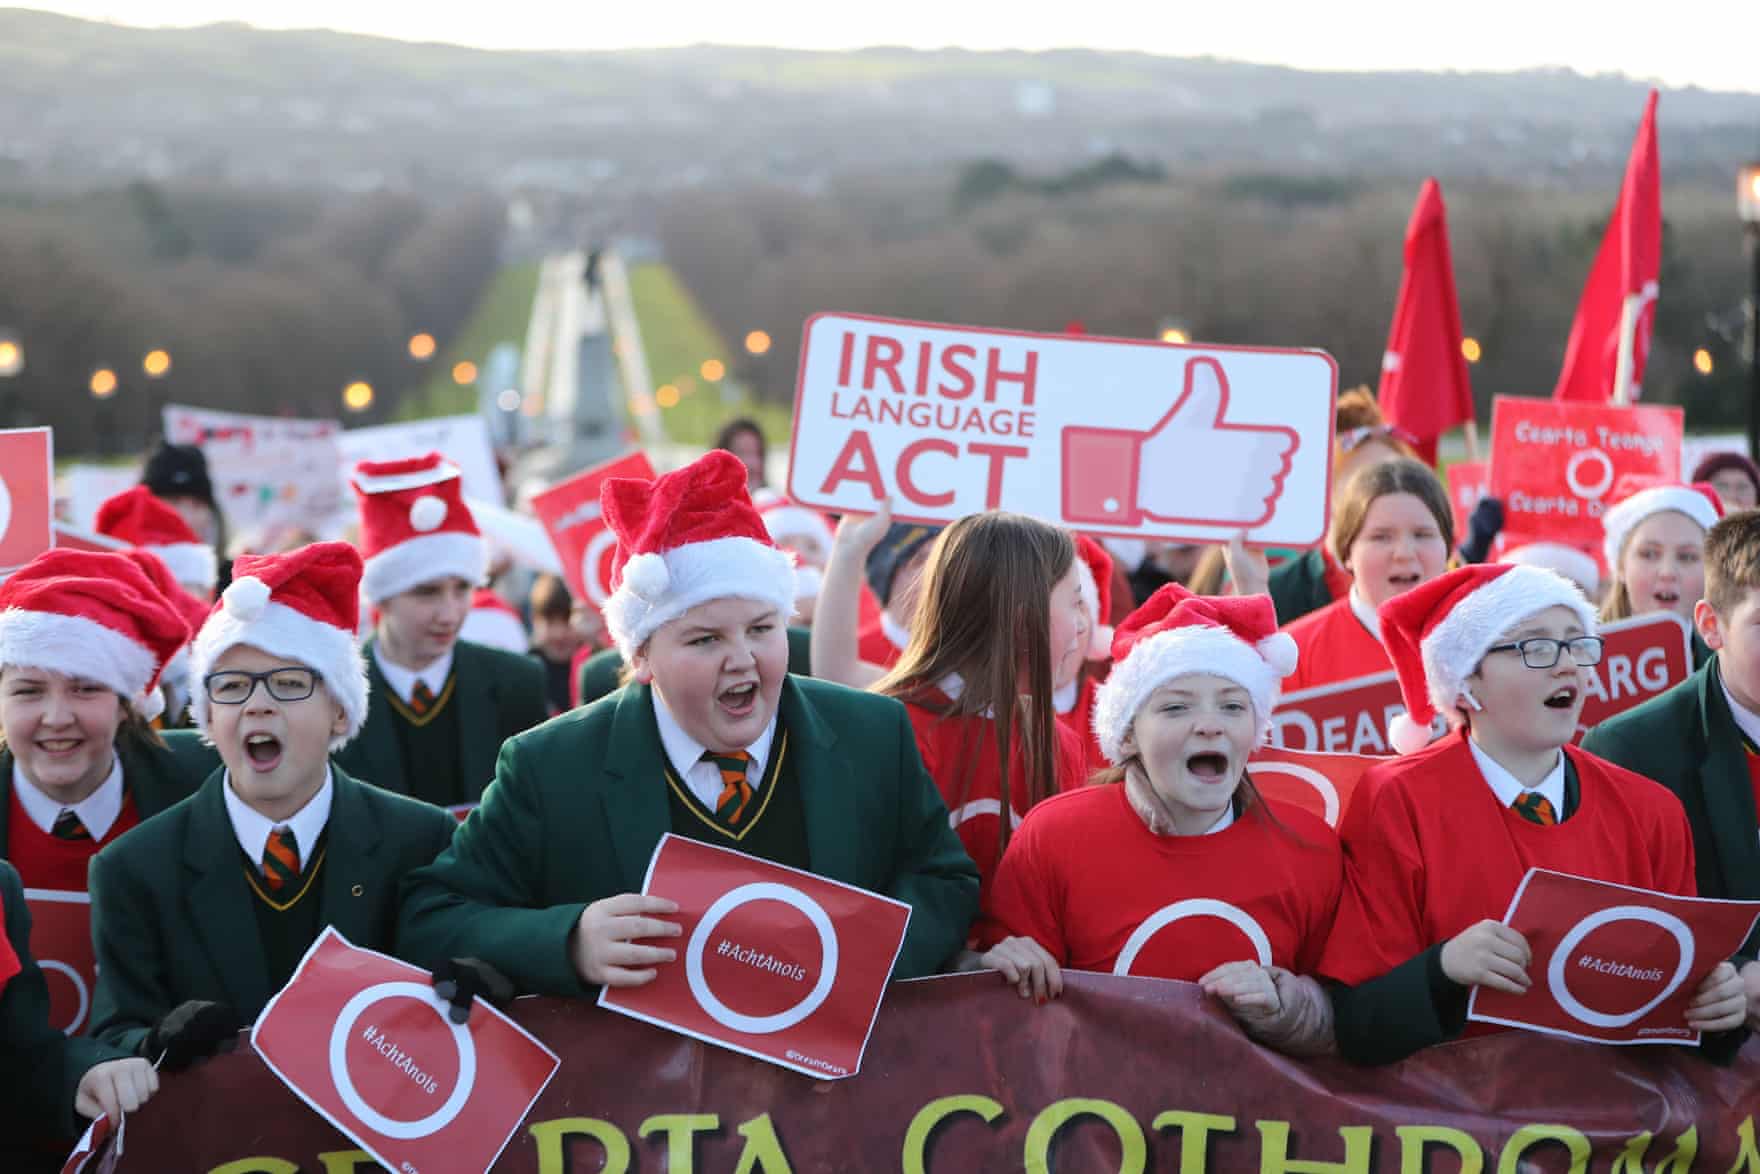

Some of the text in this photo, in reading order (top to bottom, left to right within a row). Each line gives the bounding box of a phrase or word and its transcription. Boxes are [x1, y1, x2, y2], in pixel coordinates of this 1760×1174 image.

[837, 331, 1038, 405] IRISH
[831, 392, 1036, 437] LANGUAGE
[820, 429, 1029, 510] ACT
[1582, 646, 1670, 703] ARG
[717, 939, 806, 981] #AchtAnois
[1578, 955, 1664, 981] #AchtAnois
[363, 1025, 439, 1094] #AchtAnois
